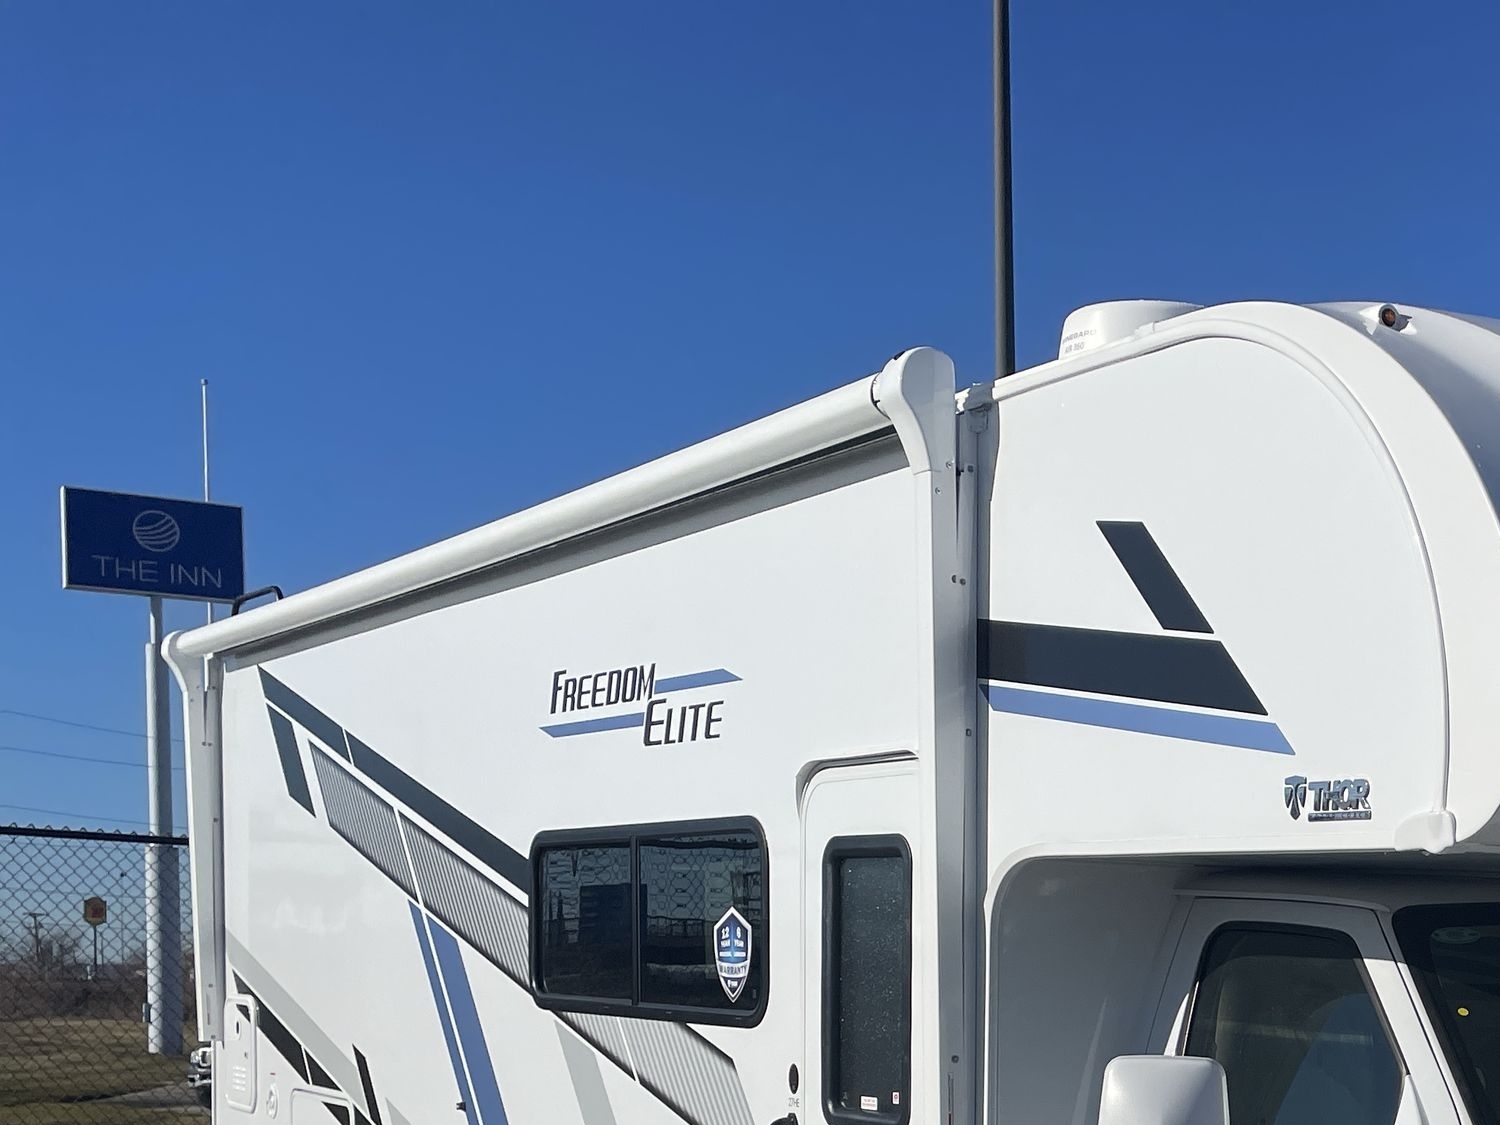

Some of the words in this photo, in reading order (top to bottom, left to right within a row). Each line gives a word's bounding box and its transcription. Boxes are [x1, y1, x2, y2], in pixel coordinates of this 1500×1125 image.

[91, 554, 160, 583] THE
[170, 562, 222, 589] INN
[550, 662, 657, 715] FREEDOM
[643, 698, 725, 747] ELITE
[1308, 778, 1372, 812] THOR
